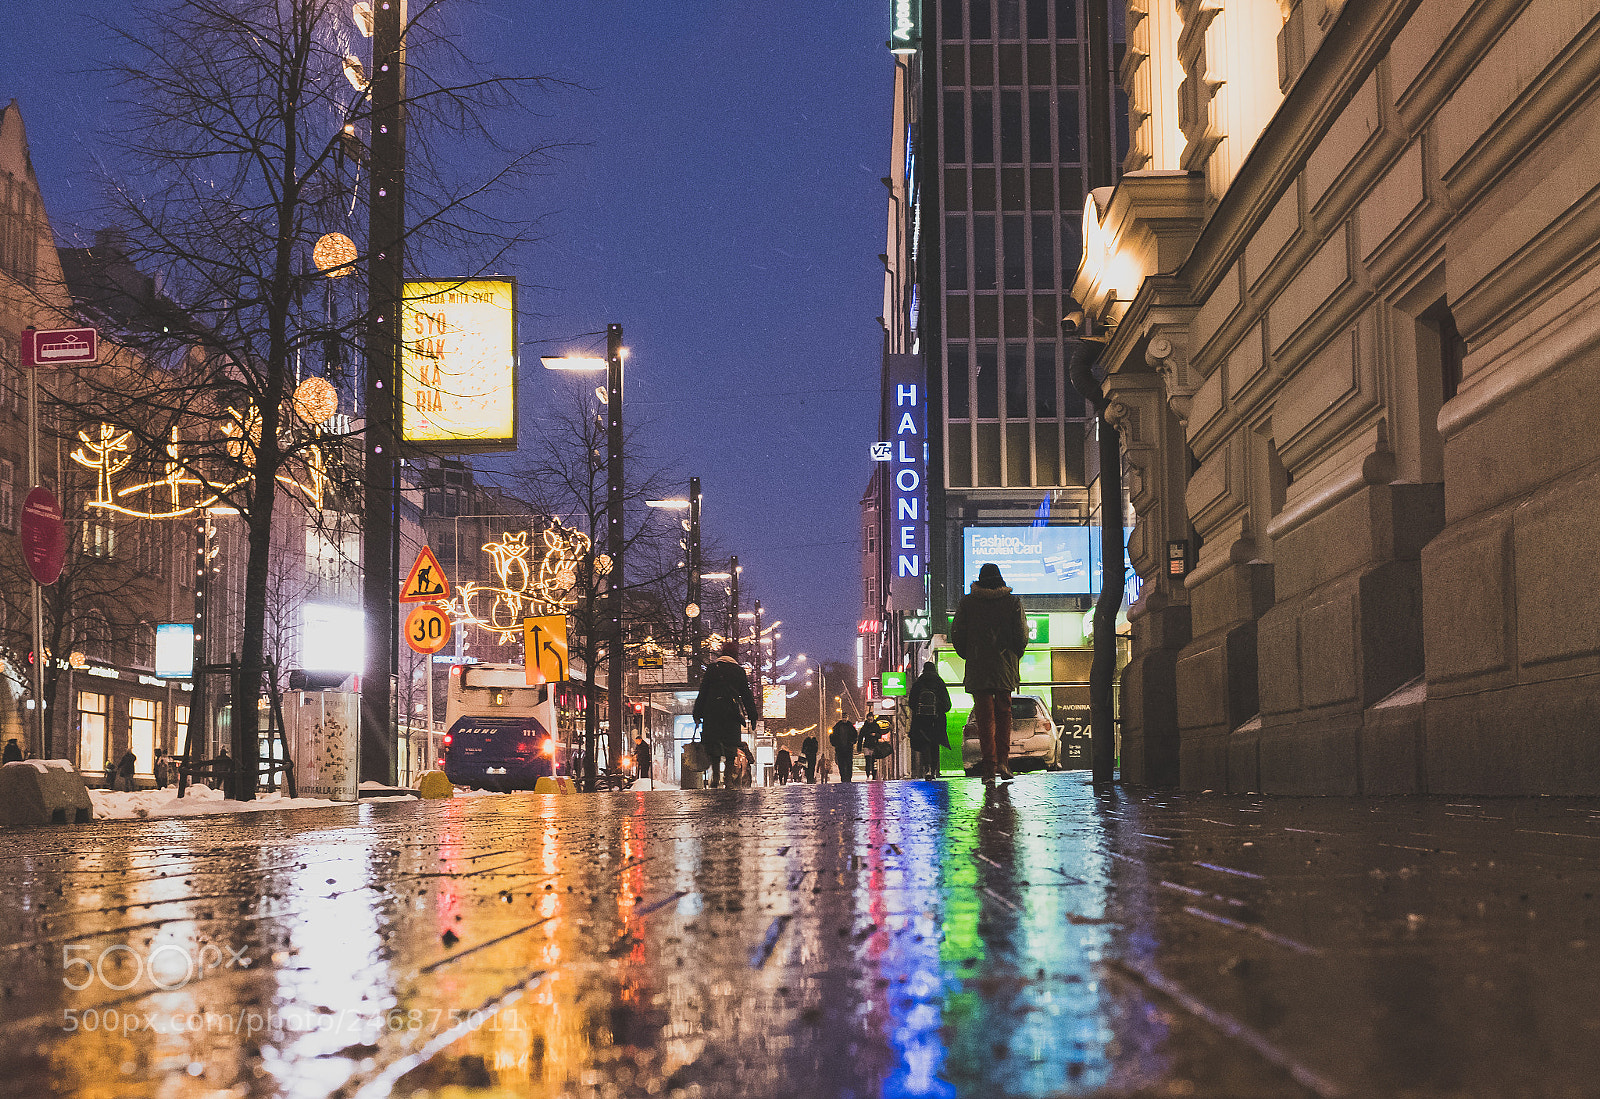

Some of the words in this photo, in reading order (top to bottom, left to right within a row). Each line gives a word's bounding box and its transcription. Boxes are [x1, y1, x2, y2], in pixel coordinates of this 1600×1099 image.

[896, 384, 920, 577] HALONEN
[971, 535, 1020, 547] Fashion
[1014, 541, 1042, 554] Card
[413, 616, 442, 642] 30
[496, 693, 503, 705] 6
[523, 729, 536, 737] 111
